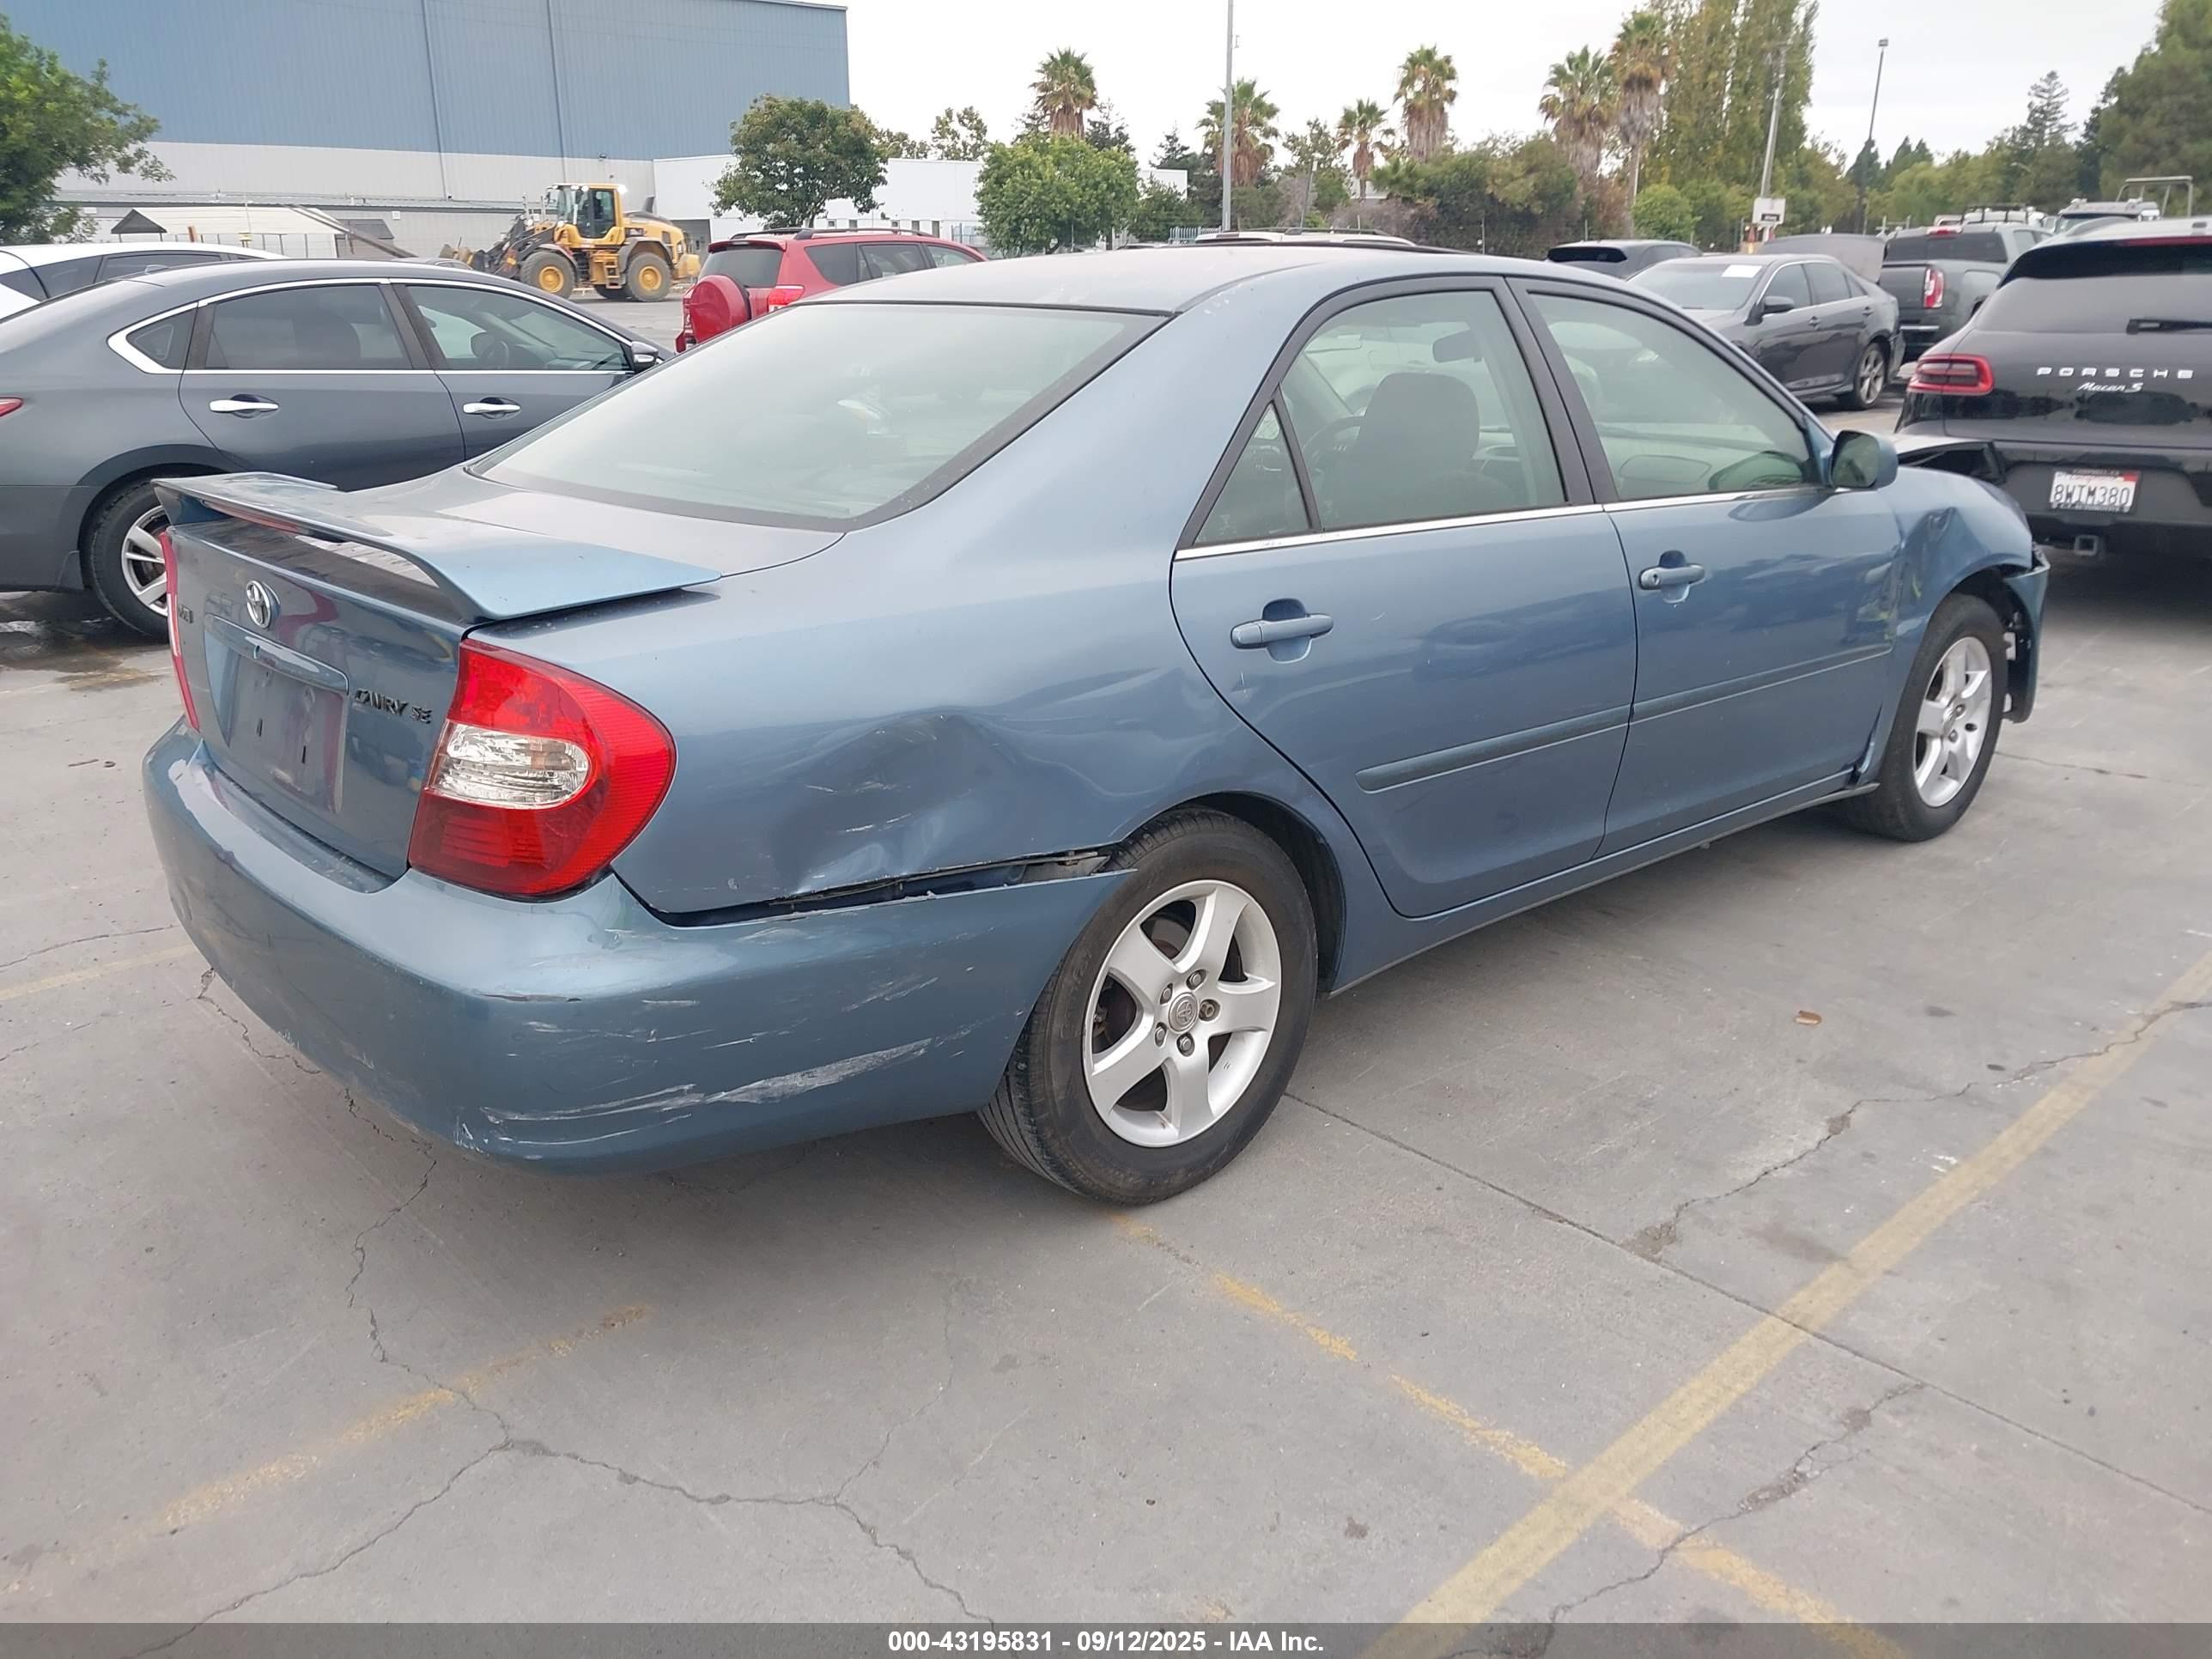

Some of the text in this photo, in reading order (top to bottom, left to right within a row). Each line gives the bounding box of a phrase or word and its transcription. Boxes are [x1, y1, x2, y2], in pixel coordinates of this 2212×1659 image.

[2036, 367, 2194, 379] PORSCHE
[2076, 381, 2144, 393] Macan S
